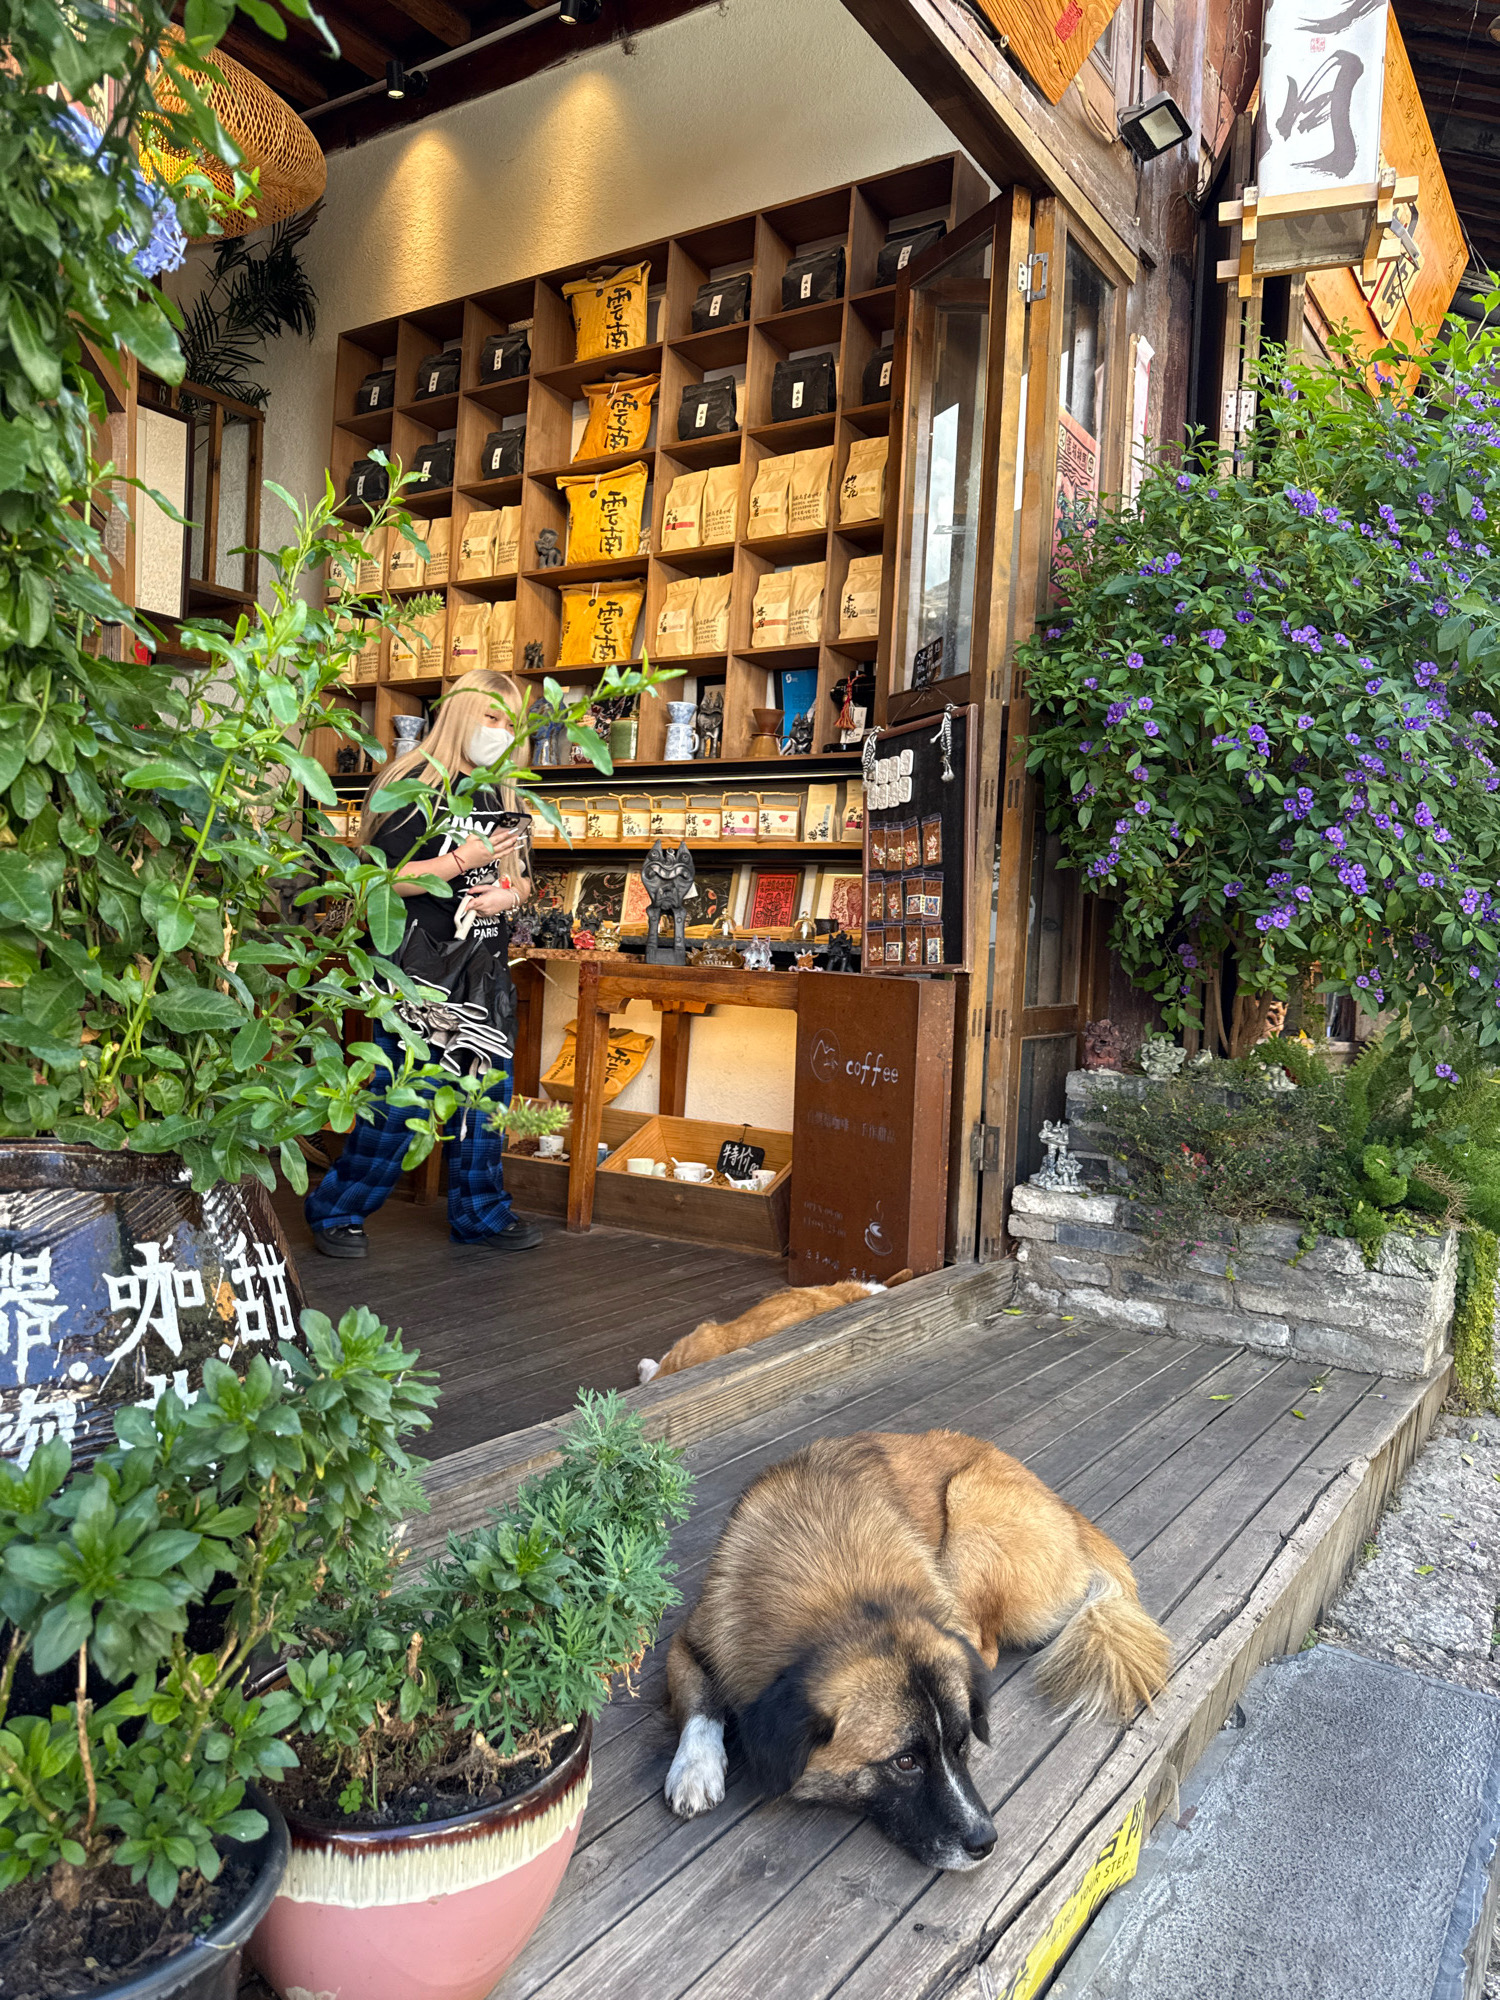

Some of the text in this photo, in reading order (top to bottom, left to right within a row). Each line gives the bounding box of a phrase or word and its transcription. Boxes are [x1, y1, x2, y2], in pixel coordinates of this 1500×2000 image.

[605, 287, 632, 349] 雲南
[604, 393, 639, 450] 雲南
[600, 491, 627, 554] 雲南
[592, 601, 623, 660] 雲南
[473, 926, 499, 938] PARIS
[846, 1051, 899, 1088] coffee
[723, 1144, 754, 1173] 特价
[1103, 1851, 1130, 1879] STEP
